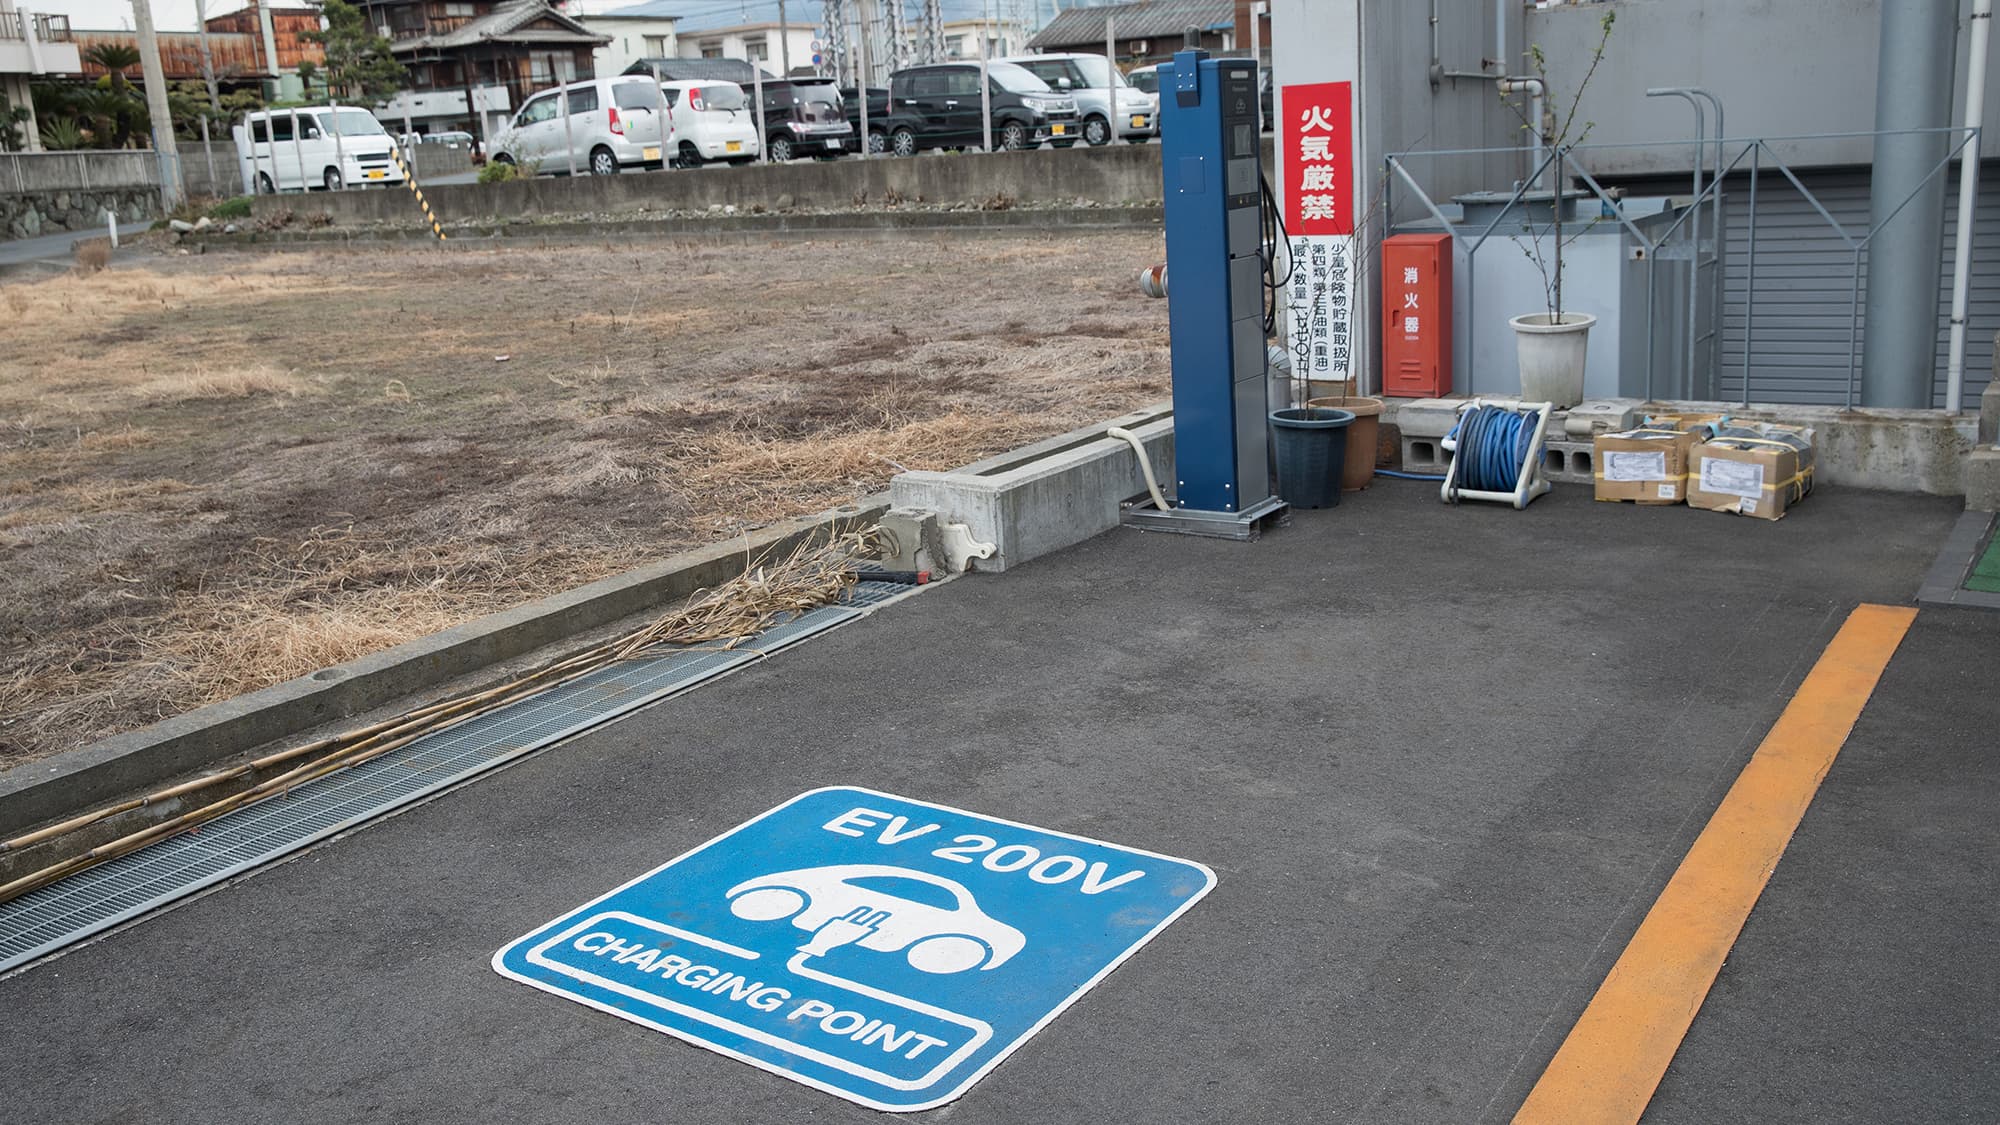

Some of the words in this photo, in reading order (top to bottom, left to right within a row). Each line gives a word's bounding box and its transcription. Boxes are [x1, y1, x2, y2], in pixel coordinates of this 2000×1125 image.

[1300, 105, 1335, 221] 火気厳禁
[1328, 243, 1348, 372] 少量危険物貯蔵取扱所
[1404, 266, 1420, 333] 消火器
[822, 808, 940, 846] EV
[930, 834, 1146, 895] 200V
[573, 933, 791, 1012] CHARGING
[786, 998, 949, 1062] POINT
